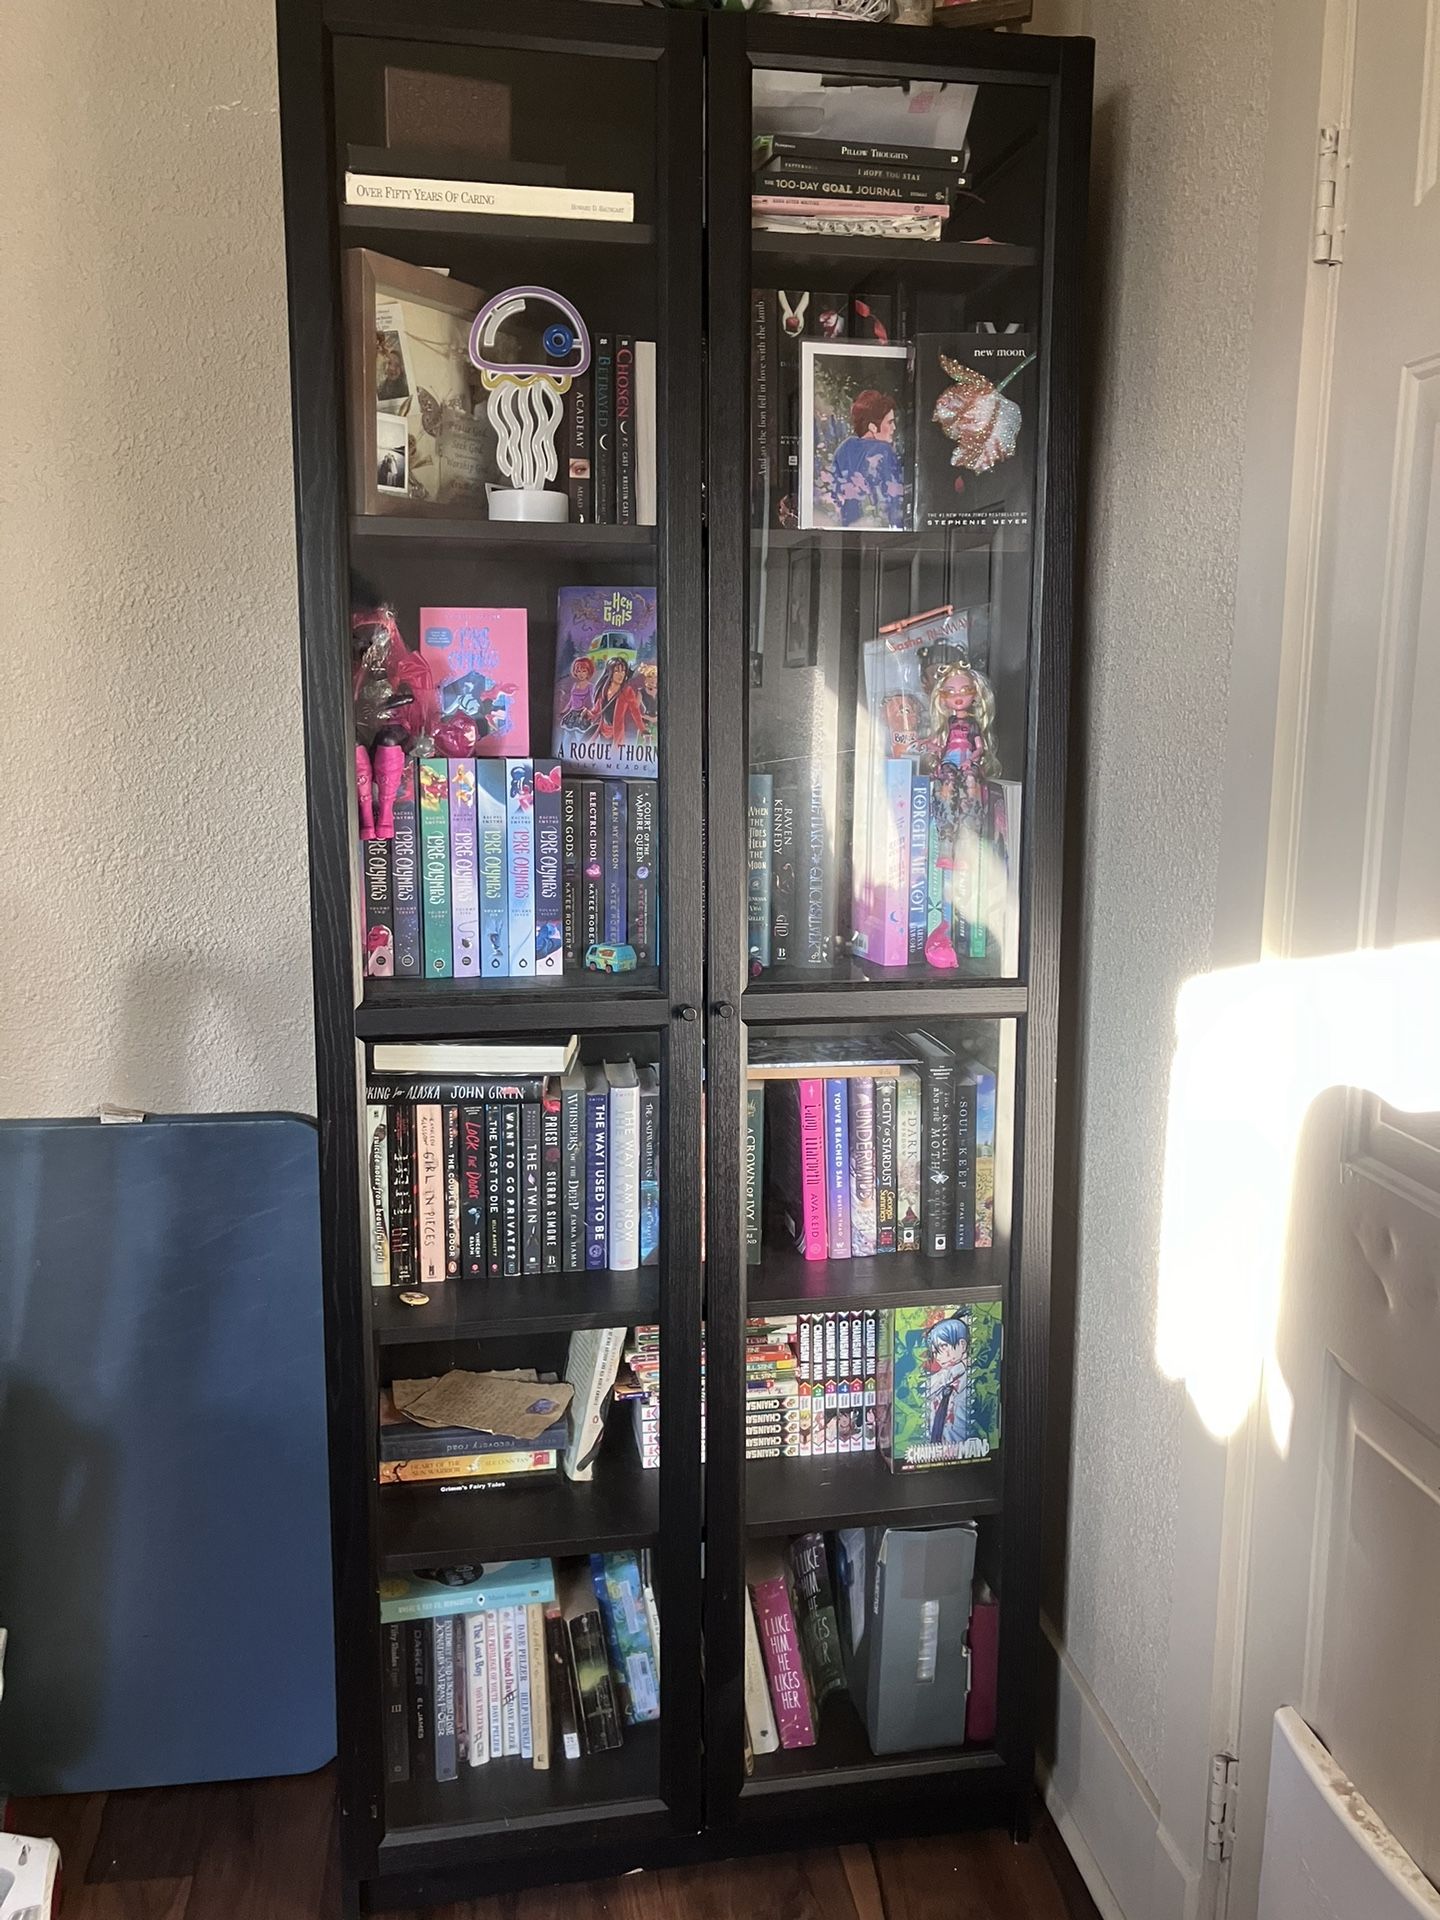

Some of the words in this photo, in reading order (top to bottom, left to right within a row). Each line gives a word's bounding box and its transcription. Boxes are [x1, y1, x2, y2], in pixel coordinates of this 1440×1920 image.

[841, 146, 868, 156] PILLOW
[870, 148, 908, 159] THOUGHTS
[356, 184, 382, 198] OVER
[385, 186, 412, 200] FIFTY
[414, 188, 443, 201] YEARS
[444, 190, 459, 202] OF
[460, 192, 495, 204] CARING
[776, 180, 819, 190] 100-DAY
[822, 183, 853, 194] GOAL
[856, 186, 902, 198] JOURNAL
[997, 349, 1026, 358] moon
[598, 355, 610, 428] BETRAYED
[616, 348, 633, 418] CHOSEN
[576, 392, 584, 449] ACADEMY
[558, 741, 564, 758] A
[570, 742, 612, 761] ROGUE
[564, 790, 574, 822] NEON
[636, 794, 644, 830] VAMPIRE
[748, 807, 768, 816] WHEN
[912, 787, 927, 848] FORGET
[612, 826, 618, 838] MY
[750, 818, 764, 827] THE
[774, 799, 782, 854] KENNEDY
[784, 808, 792, 844] RAVEN
[394, 827, 414, 856] LORE
[427, 831, 445, 860] LORE
[484, 830, 502, 854] LORE
[512, 829, 530, 854] LORE
[540, 826, 558, 854] LORE
[566, 826, 574, 857] GODS
[635, 833, 644, 862] QUEEN
[480, 856, 502, 898] OLYMPUS
[510, 856, 530, 898] OLYMPUS
[536, 856, 558, 898] OLYMPUS
[911, 855, 927, 875] ME
[366, 858, 387, 900] OLYMPUS
[392, 858, 414, 900] OLYMPUS
[424, 862, 445, 904] OLYMPUS
[910, 880, 928, 912] NOT
[450, 1086, 484, 1099] JOHN
[488, 1086, 524, 1099] GREEN
[596, 1104, 604, 1128] THE
[624, 1110, 634, 1135] THE
[882, 1103, 891, 1126] CITY
[958, 1101, 968, 1136] SOUL
[466, 1122, 480, 1151] LOCK
[490, 1121, 498, 1140] THE
[506, 1112, 514, 1147] WANT
[544, 1116, 557, 1146] PRIEST
[374, 1136, 384, 1162] suicide
[526, 1144, 537, 1170] THE
[596, 1132, 605, 1158] WAY
[624, 1140, 634, 1168] WAY
[834, 1128, 842, 1168] REACHED
[931, 1128, 940, 1170] MOTH
[424, 1152, 436, 1184] GIRL
[468, 1156, 478, 1168] THE
[490, 1146, 498, 1174] LAST
[506, 1154, 514, 1168] TO
[882, 1138, 892, 1187] STARDUST
[374, 1166, 382, 1185] notes
[466, 1172, 481, 1200] DOORS
[490, 1178, 498, 1192] TO
[506, 1176, 514, 1194] GO
[596, 1170, 604, 1202] USED
[373, 1186, 383, 1206] from
[425, 1190, 436, 1206] IN
[546, 1172, 556, 1206] SIERRA
[624, 1183, 634, 1205] AM
[490, 1196, 498, 1213] DIE
[527, 1186, 537, 1224] TWIN
[596, 1205, 604, 1222] TO
[810, 1193, 818, 1212] AVA
[375, 1208, 386, 1244] beautiful
[424, 1212, 436, 1246] PIECES
[506, 1200, 515, 1260] PRIVATE?
[546, 1211, 557, 1246] SIMONE
[596, 1226, 604, 1240] BE
[624, 1209, 634, 1242] NOW
[374, 1245, 384, 1262] girls
[800, 1322, 810, 1362] CHAINSAW
[813, 1324, 822, 1363] CHAINSAW
[826, 1320, 836, 1360] CHAINSAW
[840, 1320, 848, 1360] CHAINSAW
[852, 1320, 862, 1358] CHAINSAW
[866, 1318, 876, 1358] CHAINSAW
[800, 1362, 810, 1379] MAN
[814, 1364, 822, 1380] MAN
[826, 1360, 835, 1376] MAN
[840, 1360, 848, 1376] MAN
[852, 1359, 862, 1376] MAN
[866, 1358, 876, 1374] MAN
[446, 1444, 468, 1452] road
[472, 1441, 514, 1450] recovery
[904, 1442, 960, 1464] CHAINSAW
[958, 1438, 990, 1459] MAN
[440, 1484, 468, 1492] Grimm's
[470, 1483, 486, 1491] Fairy
[390, 1624, 400, 1640] Fifty
[474, 1622, 482, 1639] The
[518, 1624, 526, 1646] DAVE
[764, 1620, 770, 1636] I
[770, 1614, 790, 1636] LIKE
[391, 1642, 400, 1667] Shades
[414, 1630, 423, 1684] DARKER
[474, 1640, 484, 1660] Lost
[770, 1634, 792, 1655] HIM.
[474, 1661, 484, 1676] Boy
[520, 1648, 528, 1681] PELZER
[778, 1652, 790, 1672] HE
[774, 1670, 800, 1692] LIKES
[520, 1692, 528, 1710] HELP
[781, 1690, 801, 1710] HER
[522, 1713, 530, 1750] YOURSELF
